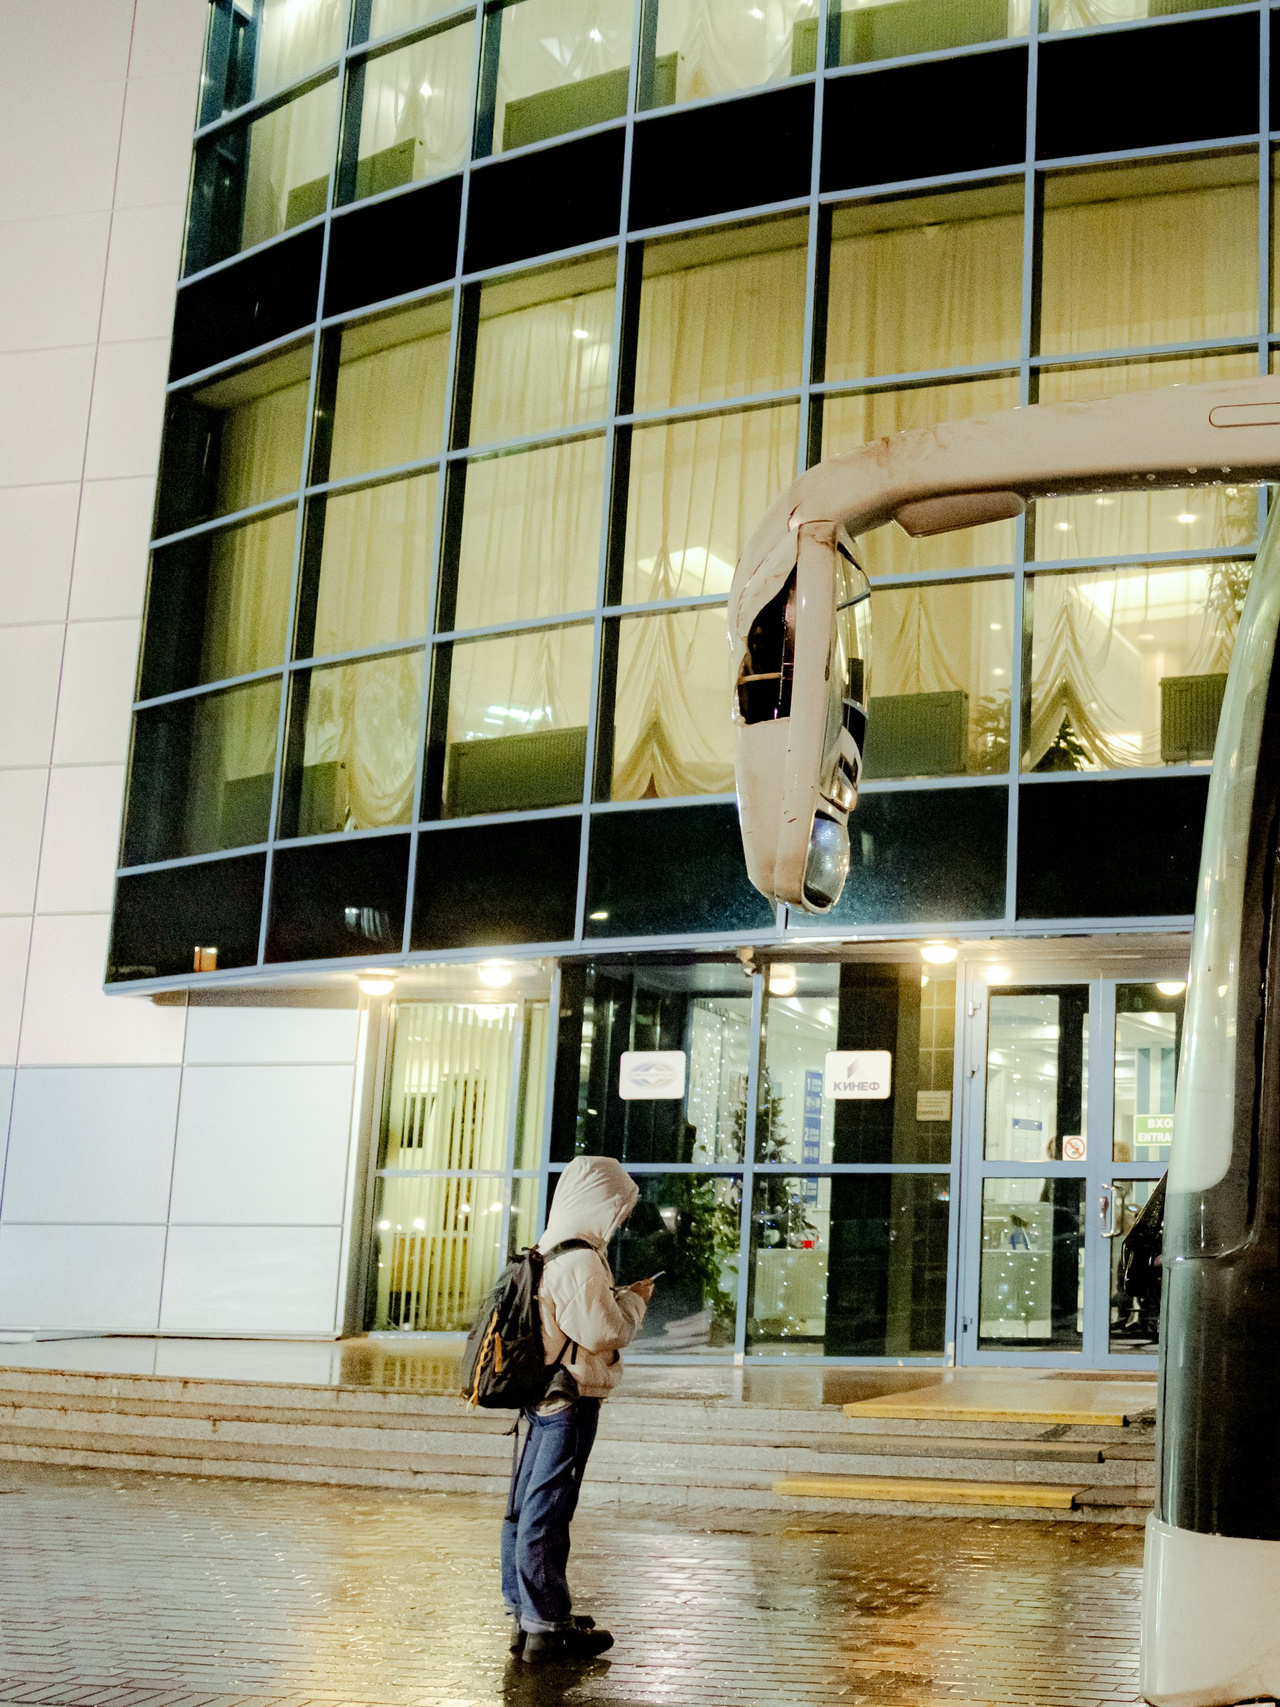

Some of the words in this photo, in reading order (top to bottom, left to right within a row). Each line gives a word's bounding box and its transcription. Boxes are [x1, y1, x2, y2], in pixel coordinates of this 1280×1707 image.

[833, 1081, 880, 1091] КИНЕФ
[1147, 1118, 1173, 1129] ВХО
[1138, 1132, 1172, 1141] ENTRA
